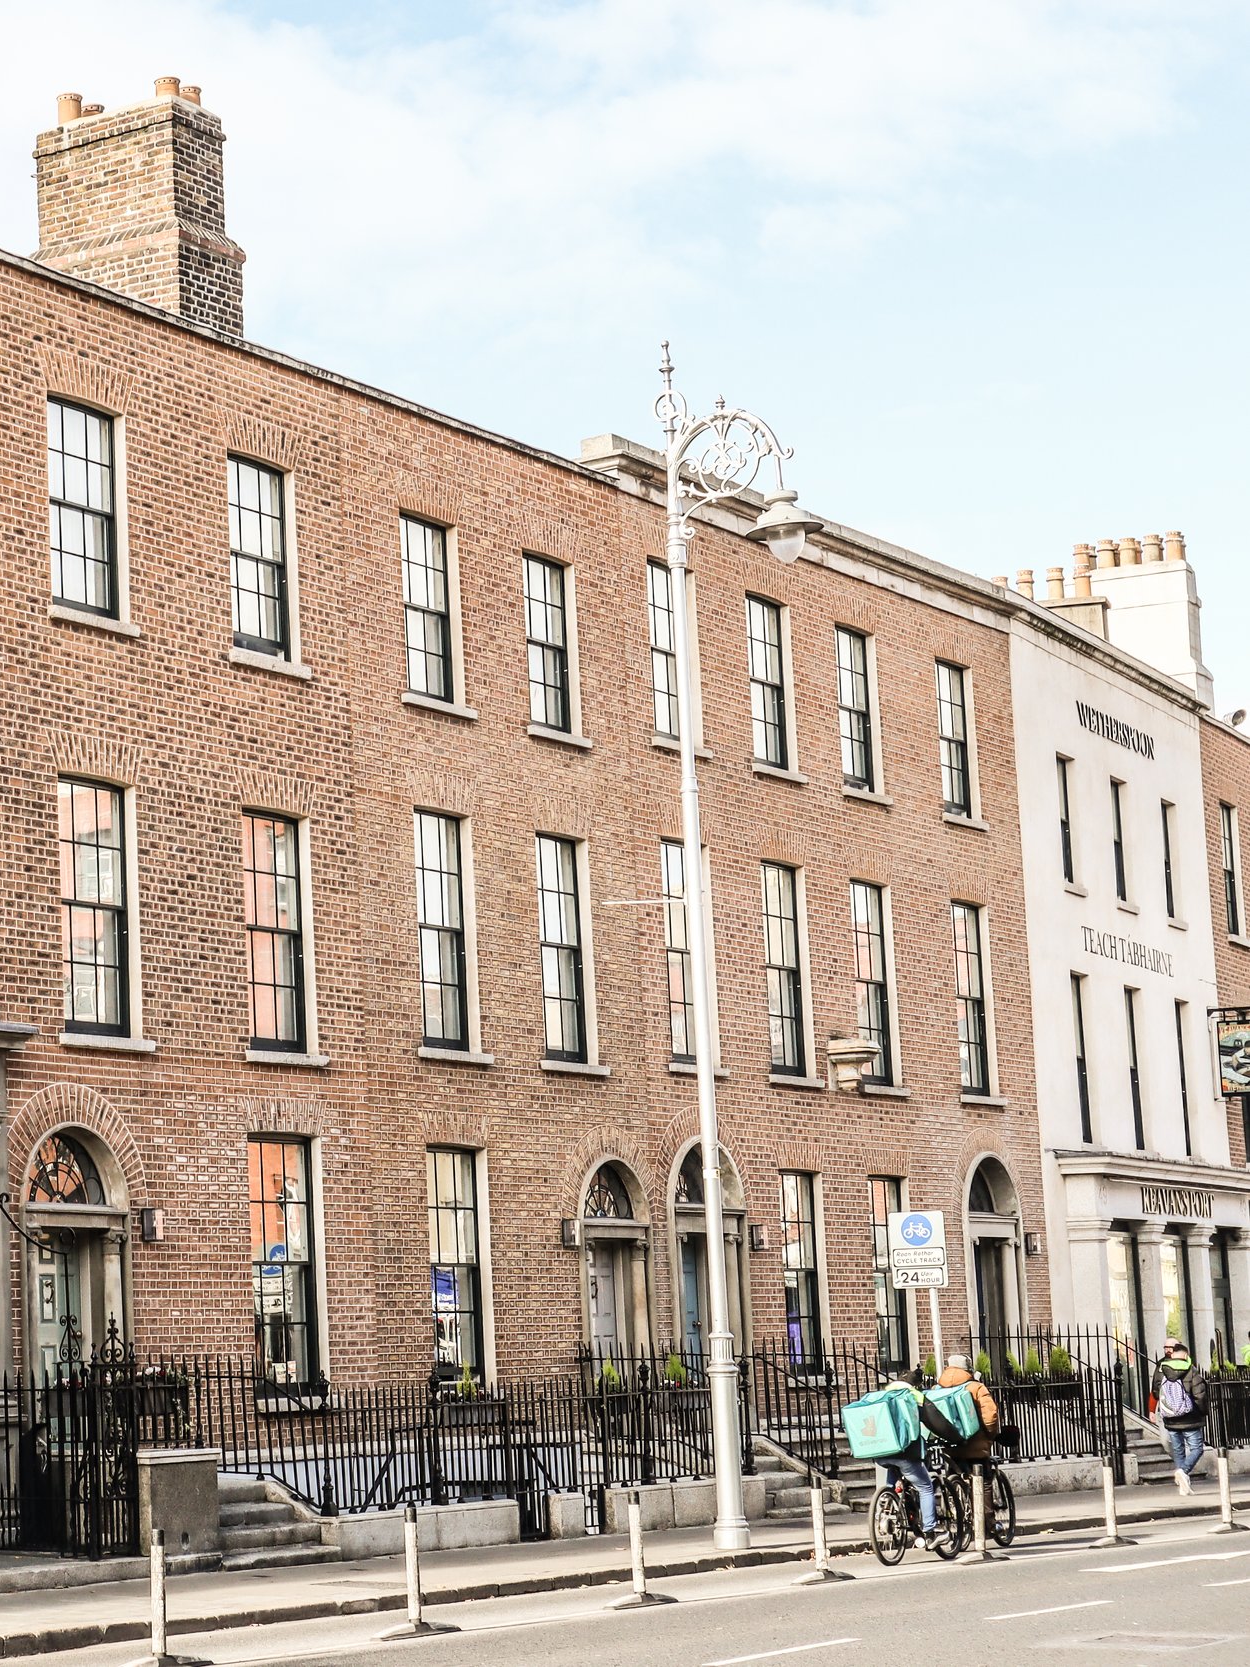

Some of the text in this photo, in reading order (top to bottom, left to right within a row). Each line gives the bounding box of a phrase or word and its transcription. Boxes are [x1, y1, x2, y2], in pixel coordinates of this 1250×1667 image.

[1076, 700, 1155, 760] WETHERSPOON
[1081, 925, 1174, 977] TEACH TÁBHAIRNE
[1188, 1190, 1215, 1218] PORT
[900, 1271, 920, 1284] 24
